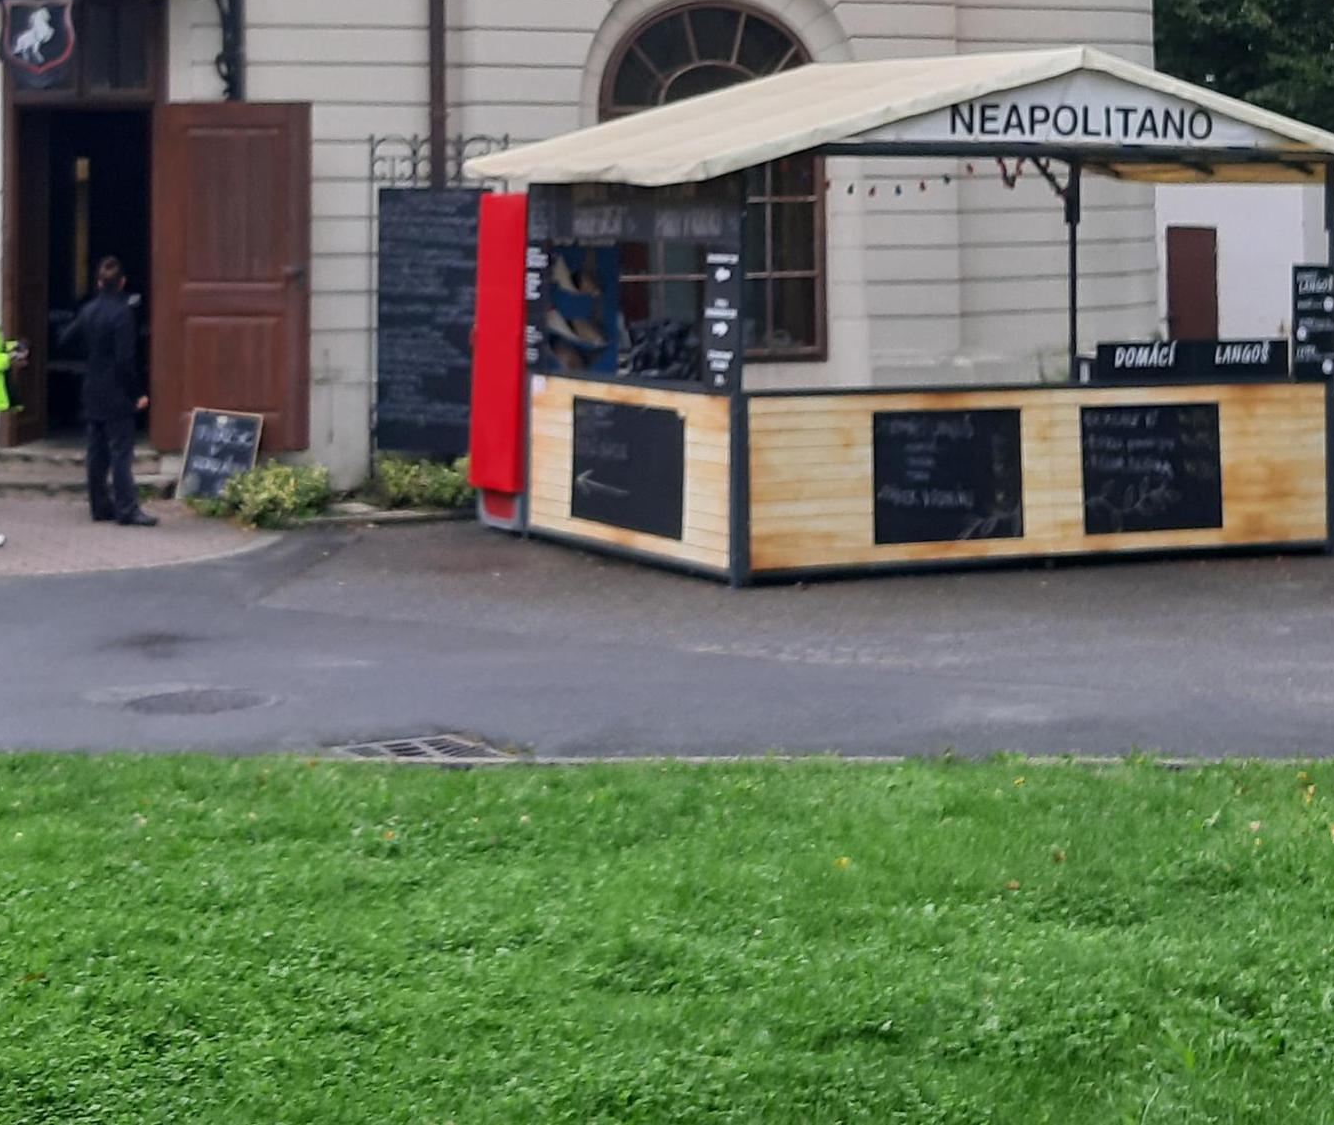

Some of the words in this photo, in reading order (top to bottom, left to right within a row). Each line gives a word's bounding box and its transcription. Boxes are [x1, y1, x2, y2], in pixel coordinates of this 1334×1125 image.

[950, 103, 1214, 140] NEAPOLITANO
[1114, 340, 1178, 368] DOMÁCÍ
[1214, 340, 1270, 364] LANGOŠ
